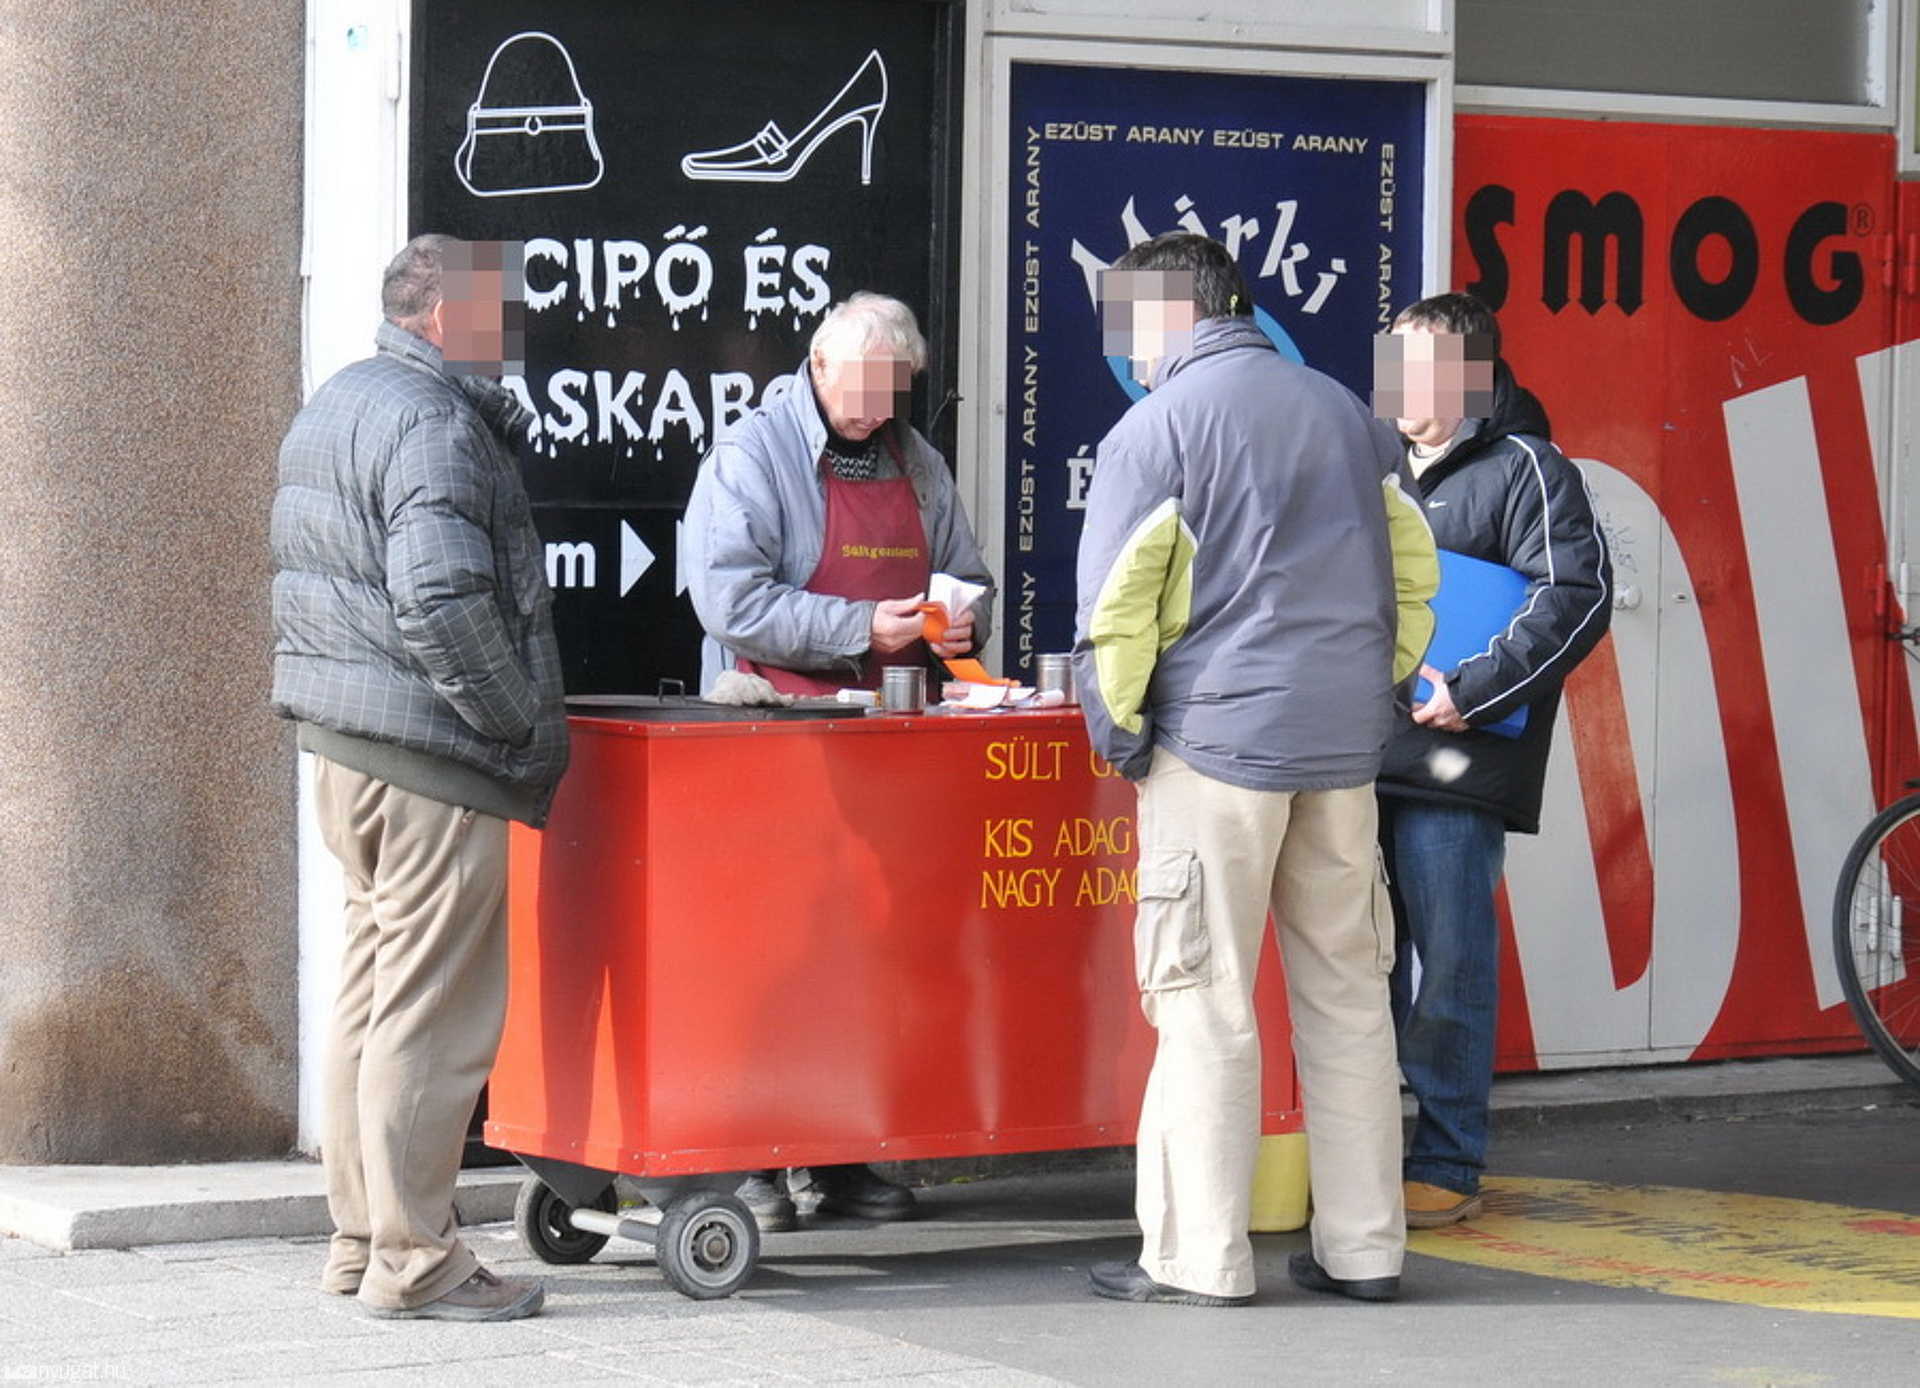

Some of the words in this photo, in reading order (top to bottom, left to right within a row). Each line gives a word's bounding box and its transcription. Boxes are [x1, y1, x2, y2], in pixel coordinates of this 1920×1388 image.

[1024, 125, 1045, 228] ARANY
[1044, 121, 1117, 142] EZÜST
[1126, 126, 1204, 146] ARANY
[1213, 128, 1283, 150] EZÜST
[1292, 133, 1368, 154] ARANY
[1380, 144, 1396, 232] EZÜST
[524, 225, 714, 330] CIPŐ
[744, 228, 832, 330] ÉS
[1022, 240, 1042, 332] EZÜST
[1022, 345, 1041, 447] ARANY
[1017, 459, 1037, 551] EZÜST
[1019, 571, 1037, 669] ARANY
[985, 735, 1069, 780] SÜLT
[984, 818, 1033, 858] KIS
[1054, 817, 1132, 857] ADAG
[980, 868, 1062, 909] NAGY
